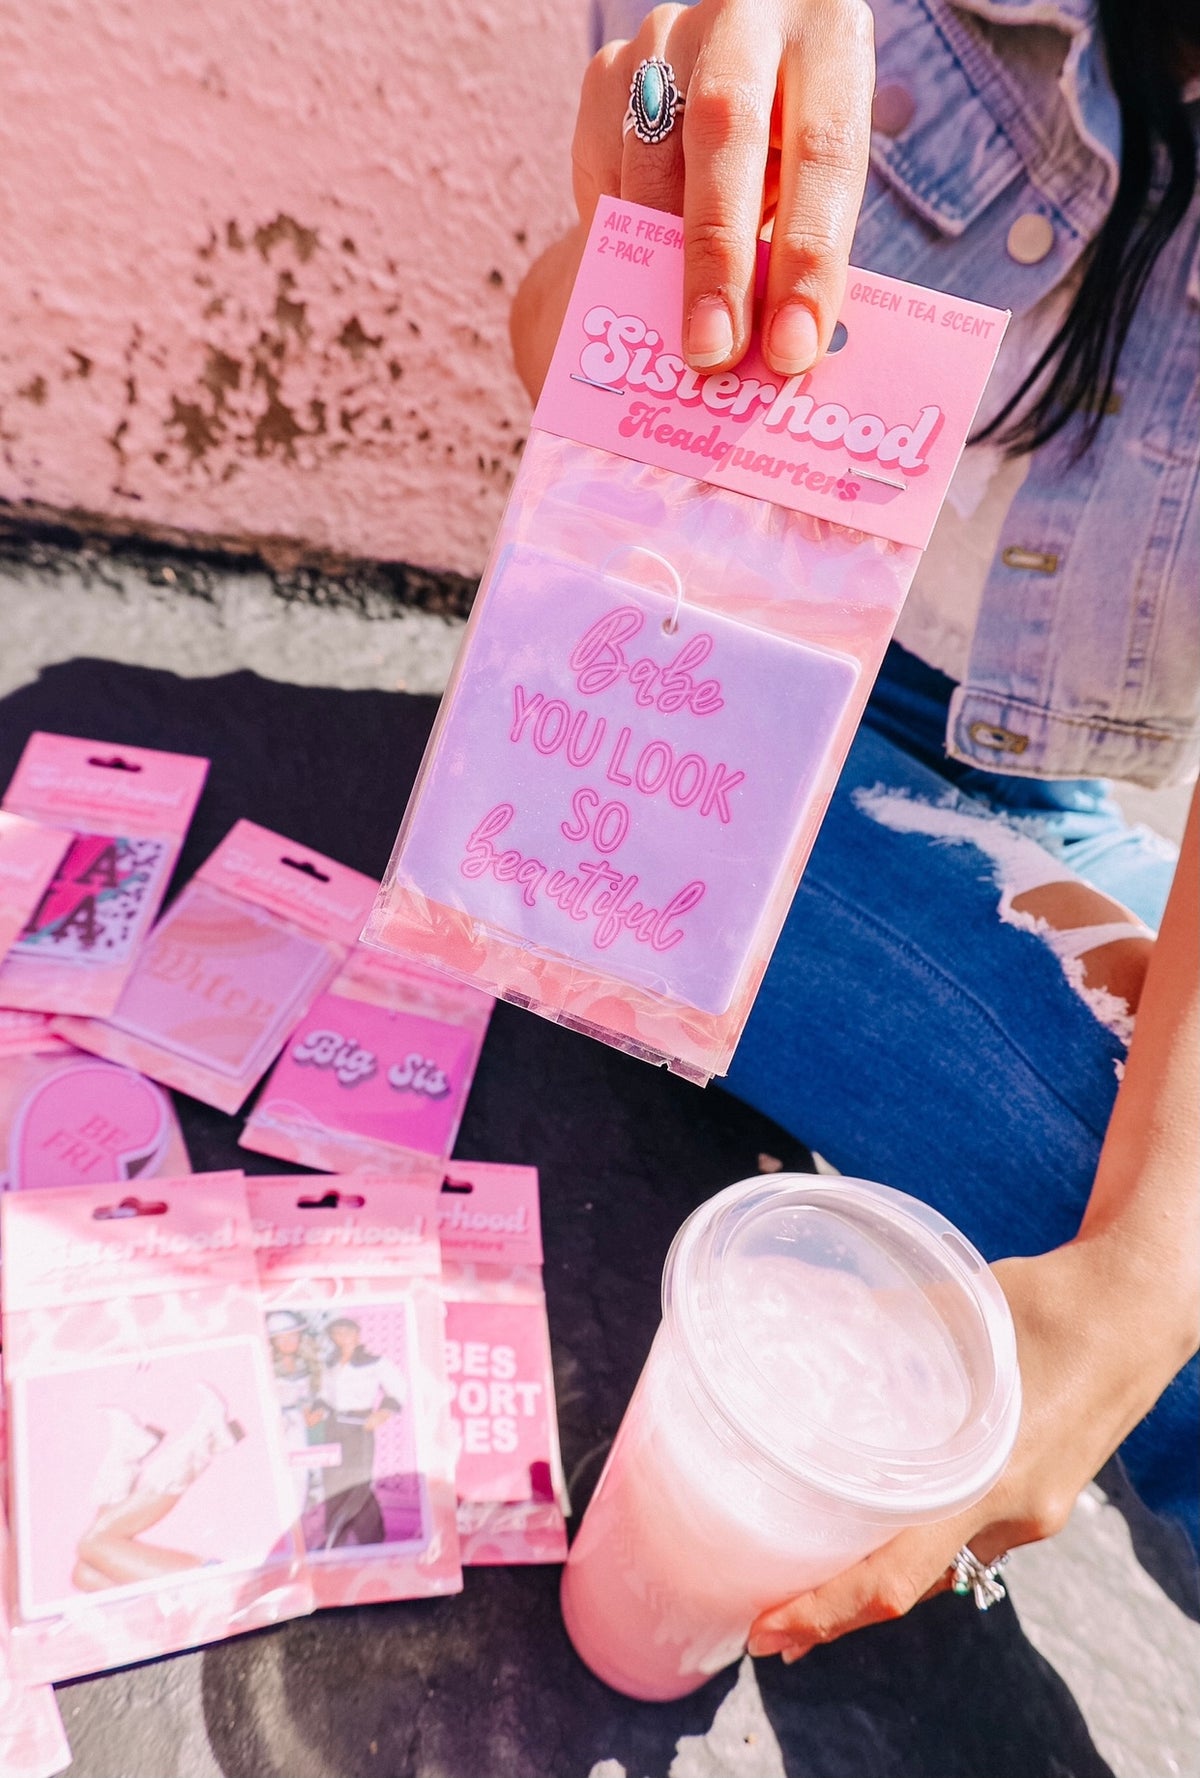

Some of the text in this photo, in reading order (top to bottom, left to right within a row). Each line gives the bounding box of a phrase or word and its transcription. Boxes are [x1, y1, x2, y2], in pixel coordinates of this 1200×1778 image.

[597, 236, 655, 267] 2-PACK
[604, 211, 632, 234] AIR
[850, 283, 996, 339] GREEN TEA SCENT
[579, 304, 945, 477] Sisterhood
[618, 401, 862, 502] Headquarters
[569, 605, 726, 717] Babe
[509, 684, 747, 824] YOU LOOK
[560, 788, 631, 854] SO
[460, 802, 706, 952] beautiful
[292, 1029, 451, 1100] Big Sis
[450, 1379, 542, 1417] ORT
[454, 1416, 519, 1454] ES
